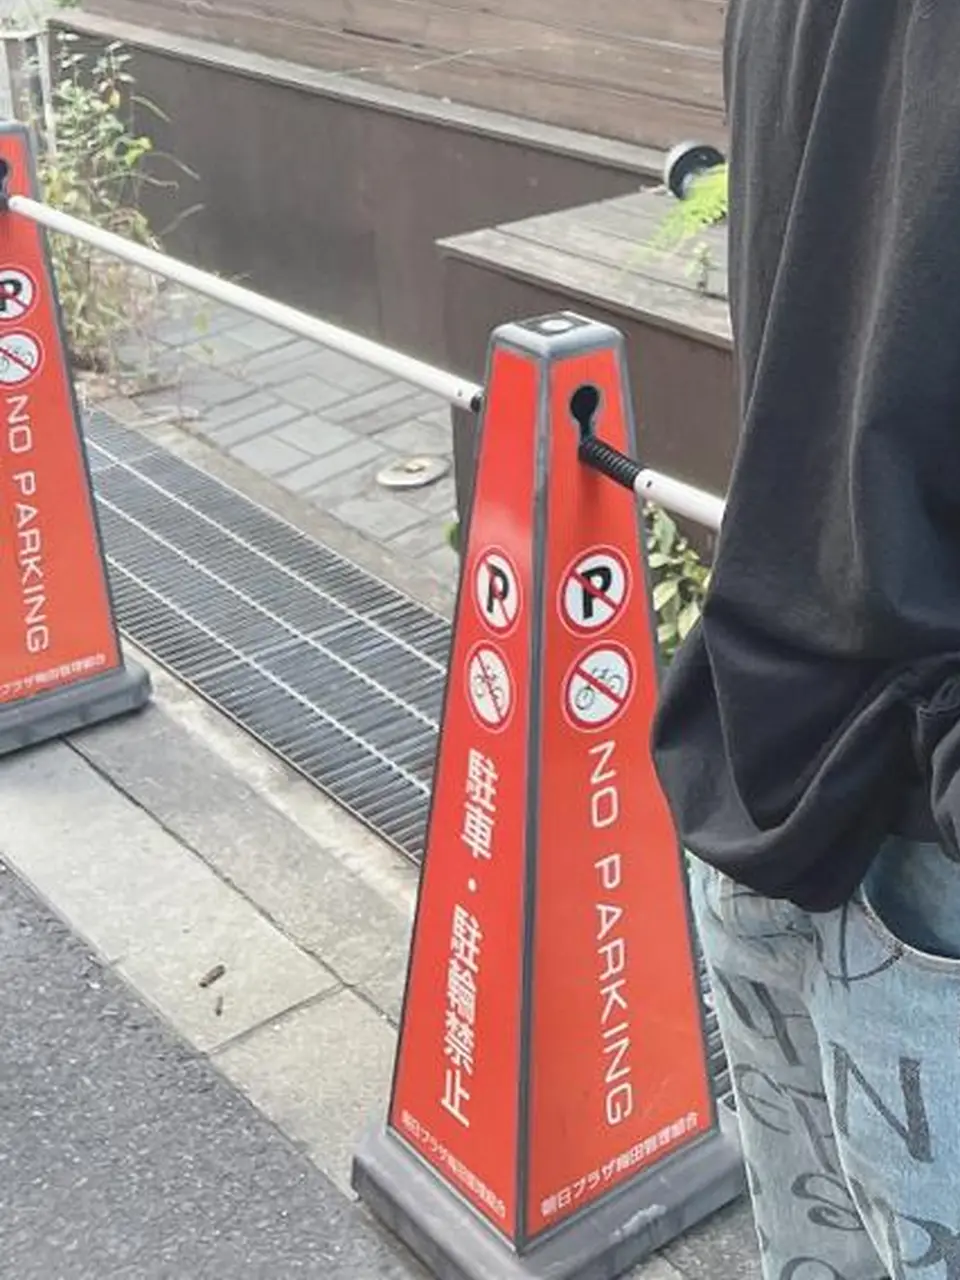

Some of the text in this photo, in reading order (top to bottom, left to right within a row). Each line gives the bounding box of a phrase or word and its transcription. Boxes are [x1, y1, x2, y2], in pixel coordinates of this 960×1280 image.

[5, 395, 49, 653] NO PARKING
[588, 741, 633, 1126] NO PARKING
